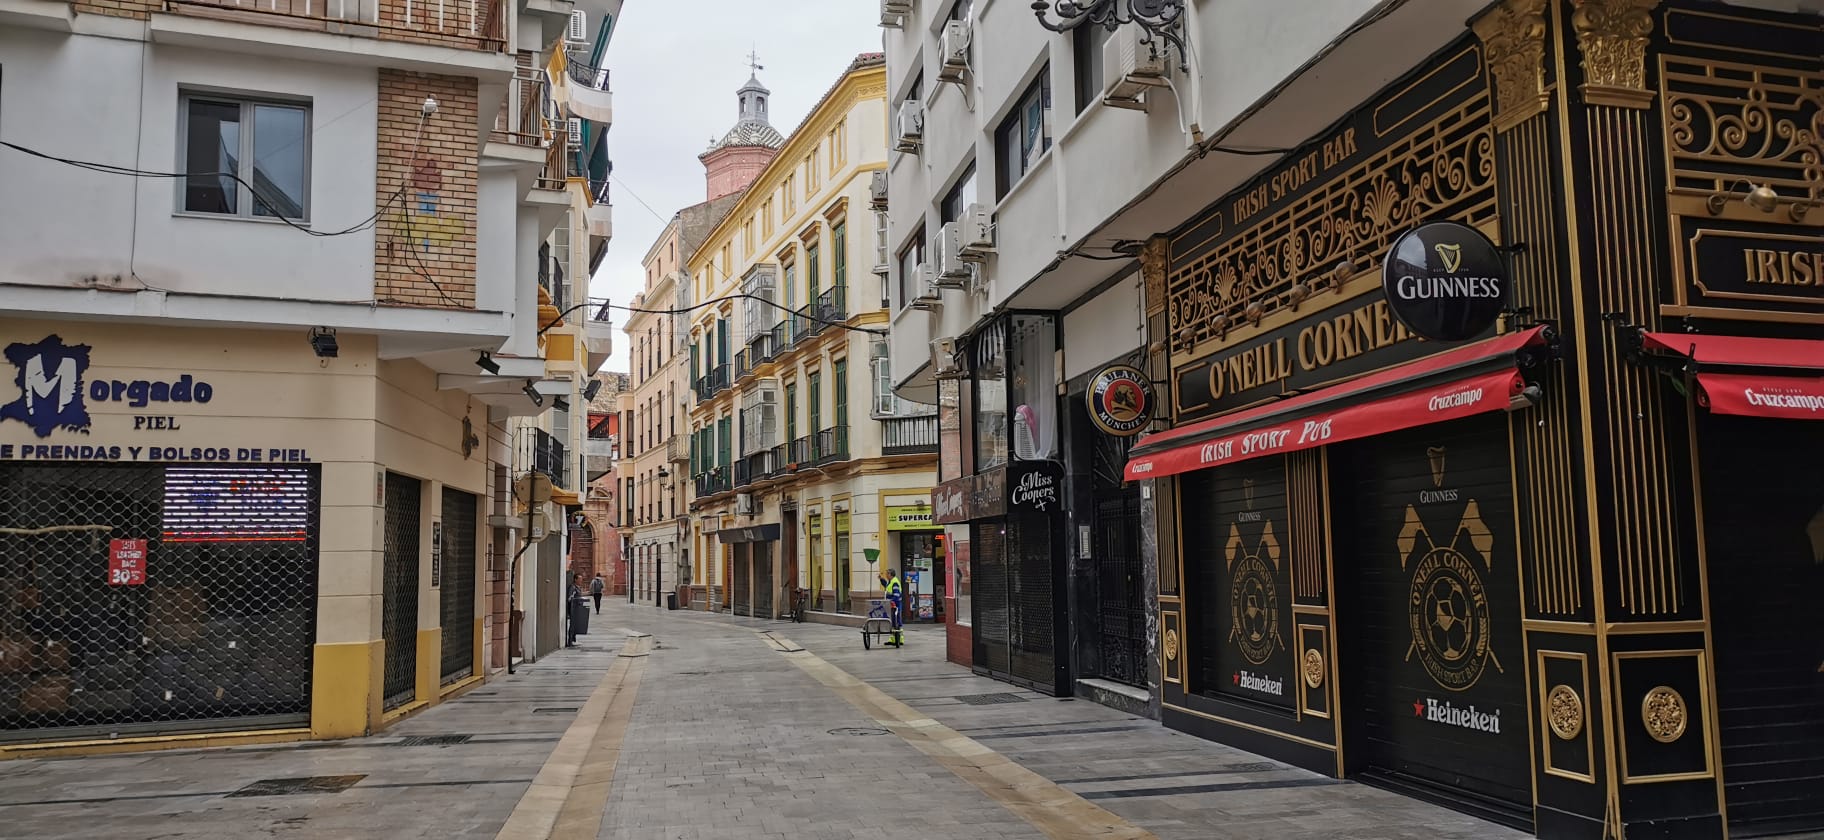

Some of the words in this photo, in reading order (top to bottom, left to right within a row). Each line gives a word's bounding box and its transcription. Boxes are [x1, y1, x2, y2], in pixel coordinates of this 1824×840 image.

[1232, 183, 1268, 225] IRISH
[1271, 150, 1318, 202] SPORT
[1323, 127, 1358, 171] BAR
[1397, 276, 1500, 300] GUINNESS
[1209, 336, 1293, 400] O'NEILL
[1428, 388, 1483, 411] Cruzcampo
[134, 416, 181, 431] PIEL
[1200, 439, 1234, 464] IRISH
[1241, 429, 1291, 455] SPORT
[1298, 418, 1332, 444] PUB
[21, 445, 121, 460] PRENDAS
[128, 446, 144, 460] Y
[149, 447, 230, 462] BOLSOS
[237, 448, 262, 462] DE
[269, 449, 312, 462] PIEL
[1021, 471, 1053, 491] Miss
[1012, 484, 1056, 505] Coopers
[1420, 489, 1458, 503] GUINNESS
[1443, 552, 1484, 608] CORNER
[1240, 670, 1283, 695] Heineken
[1427, 698, 1500, 734] Heineken
